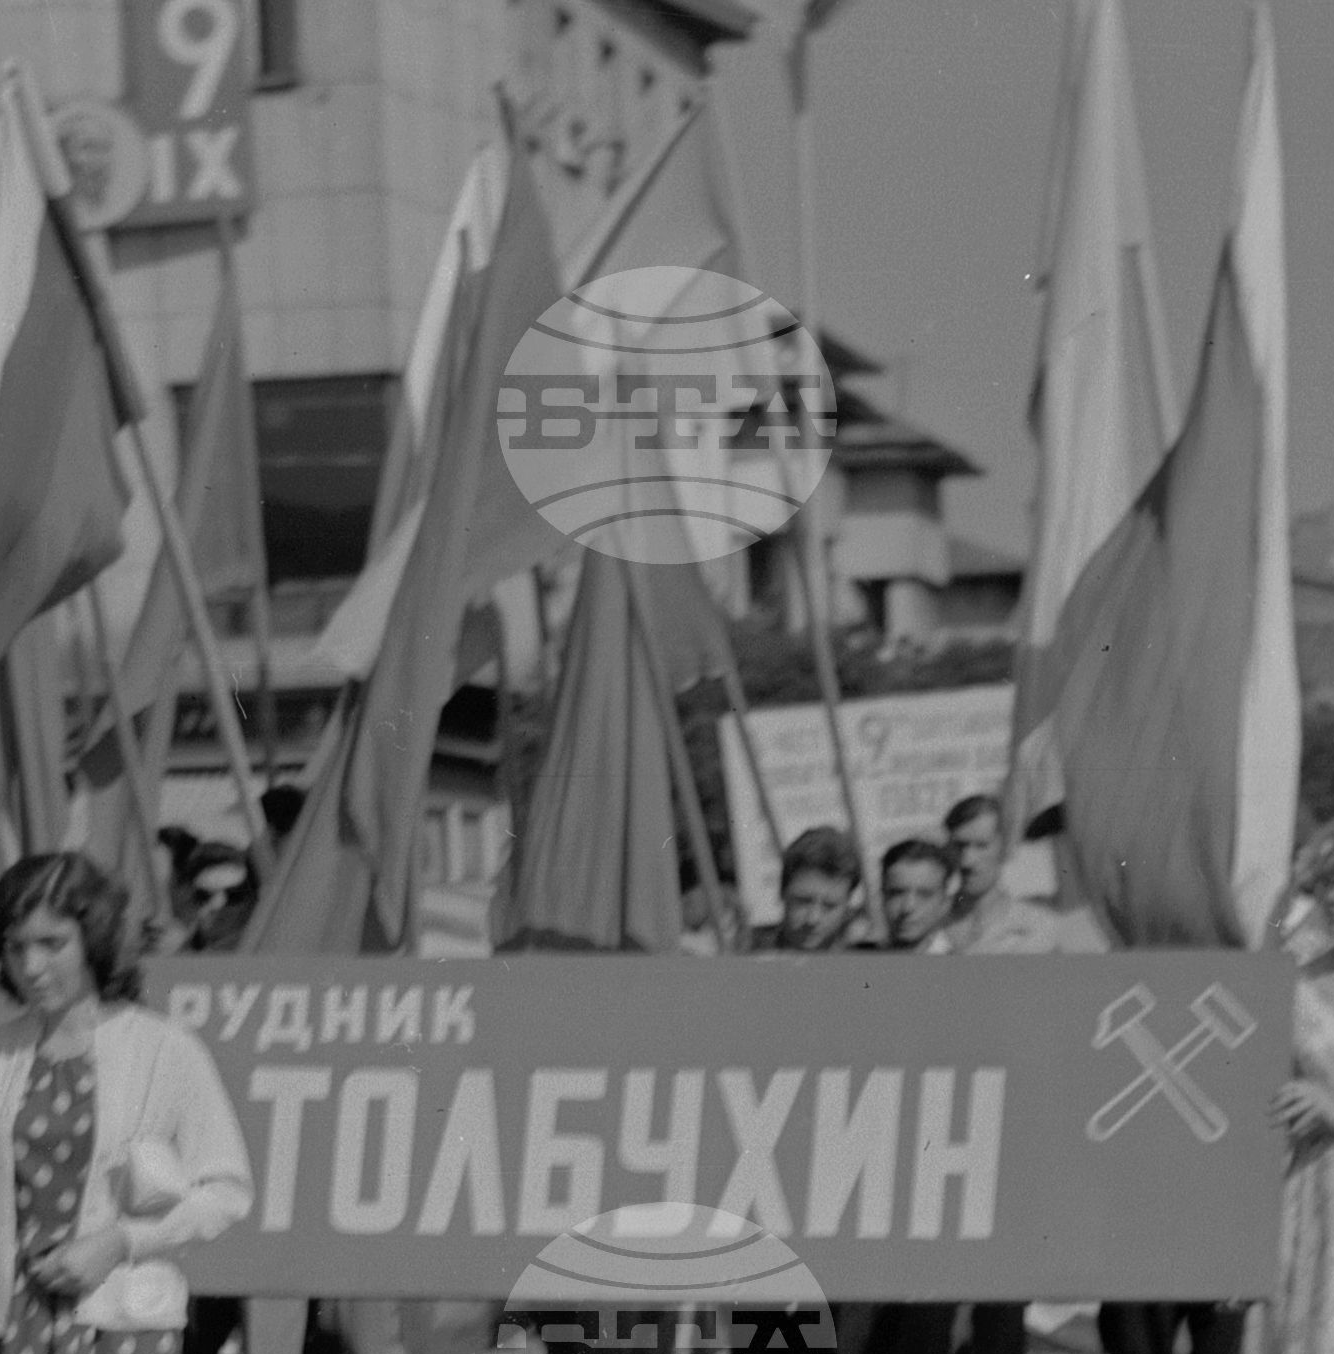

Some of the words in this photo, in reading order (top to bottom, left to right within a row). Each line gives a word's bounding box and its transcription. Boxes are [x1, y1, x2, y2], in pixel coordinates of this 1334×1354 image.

[157, 0, 238, 119] 9
[169, 981, 477, 1054] РУДНИК
[248, 1065, 1006, 1240] ТОЛБУХИН
